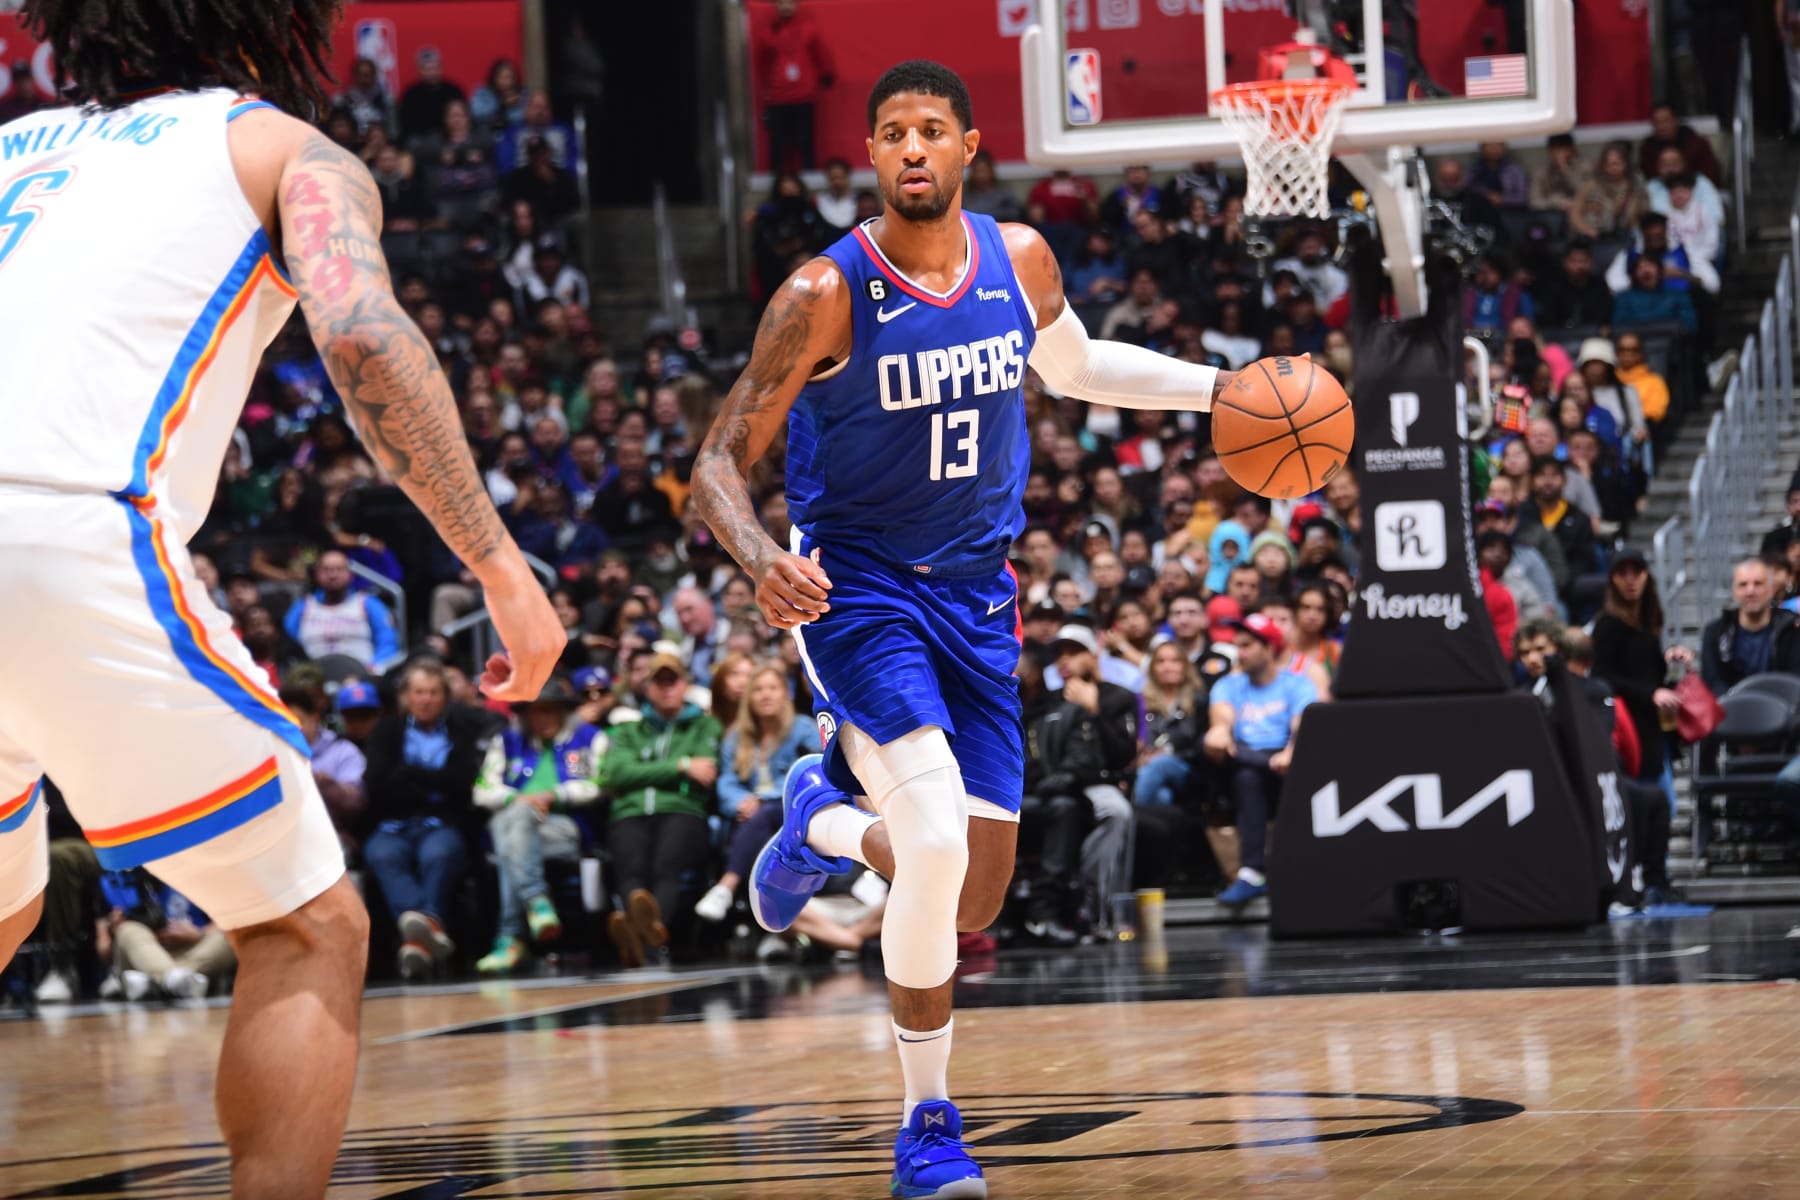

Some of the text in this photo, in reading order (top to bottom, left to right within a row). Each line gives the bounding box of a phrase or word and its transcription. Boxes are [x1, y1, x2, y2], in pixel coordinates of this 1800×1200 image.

[869, 280, 886, 300] 6
[976, 288, 1011, 302] honey
[878, 330, 1024, 411] CLIPPERS
[930, 409, 980, 481] 13
[1360, 582, 1469, 630] honey
